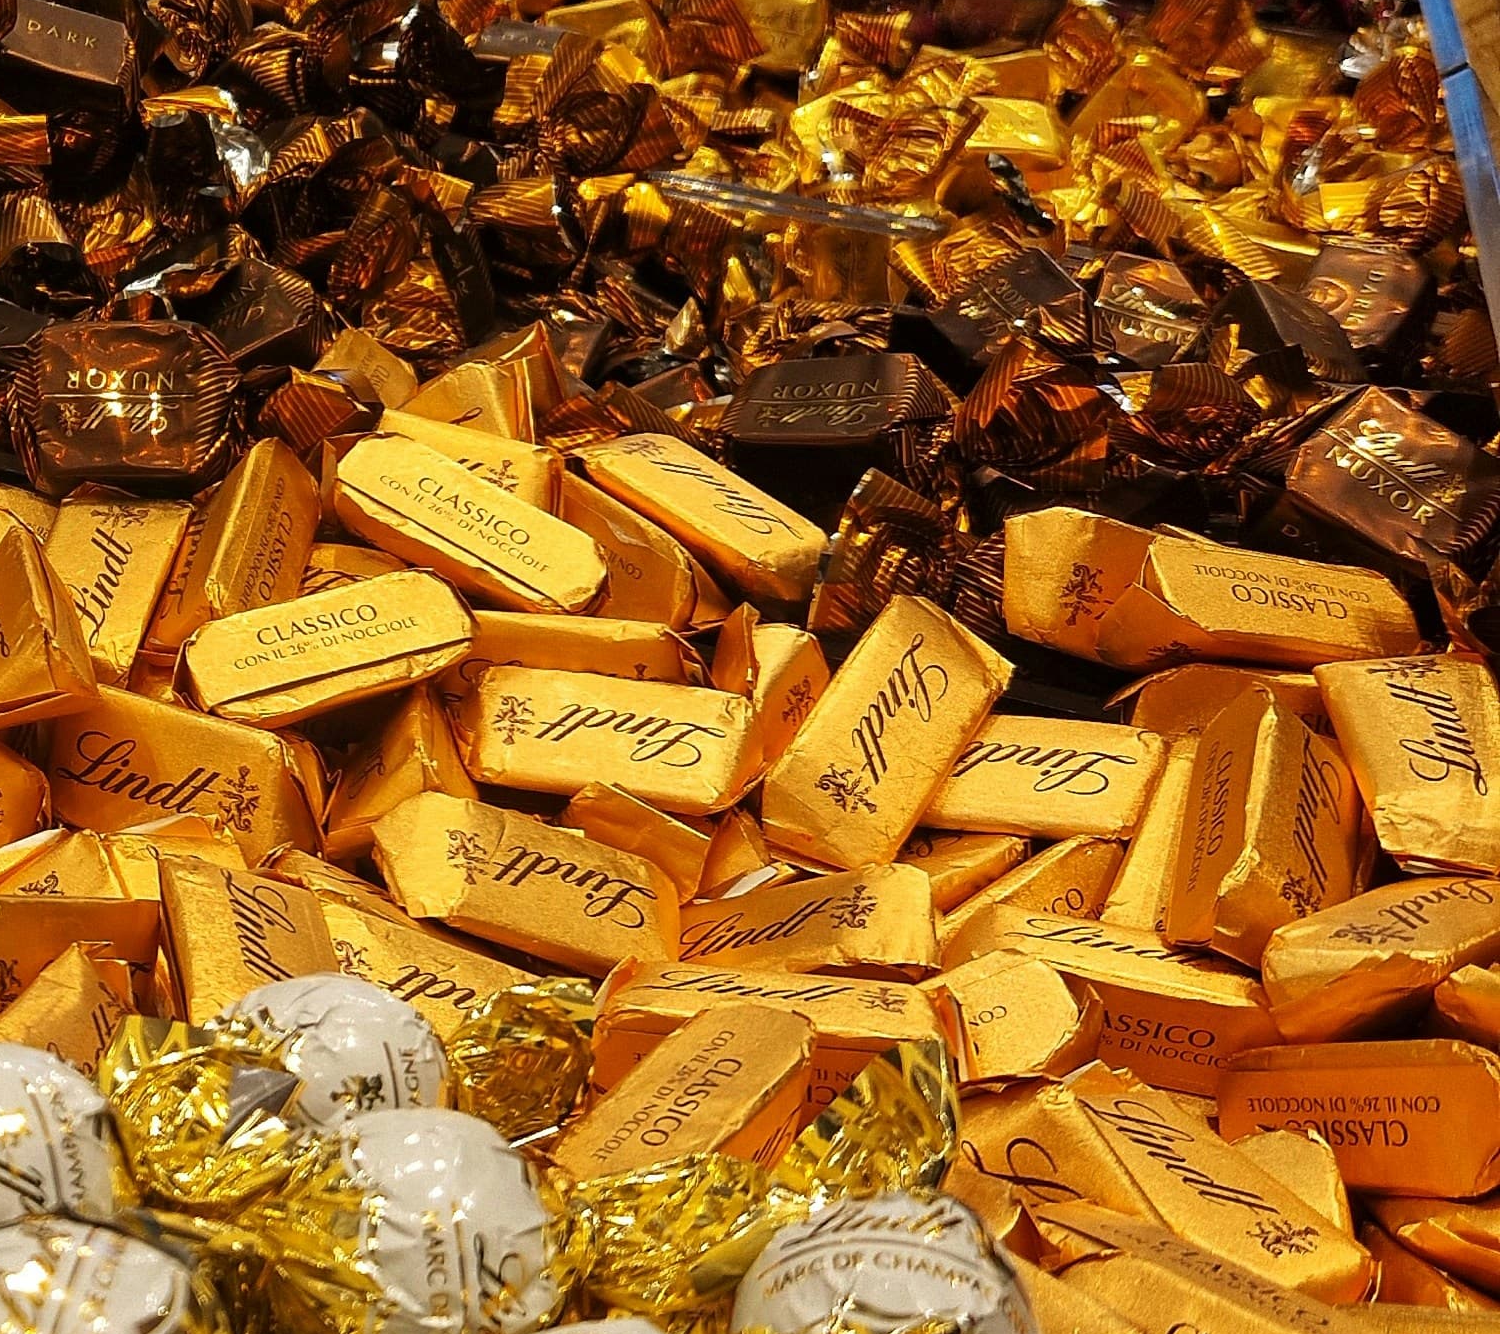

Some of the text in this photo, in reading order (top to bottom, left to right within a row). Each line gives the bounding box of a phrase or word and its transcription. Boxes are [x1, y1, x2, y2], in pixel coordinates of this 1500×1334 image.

[26, 18, 101, 50] DARK
[1348, 268, 1386, 334] DARK
[66, 370, 174, 391] NUXOR
[773, 379, 880, 399] NUXOR
[779, 401, 881, 426] Lindt
[418, 476, 532, 547] CLASSICO
[650, 457, 805, 542] Lindt
[1324, 444, 1436, 527] NUXOR
[379, 474, 411, 498] CON
[427, 503, 456, 525] 26%
[457, 518, 476, 534] DI
[477, 530, 551, 573] NOCCIOLE
[75, 525, 135, 647] Lindt
[259, 510, 294, 603] CLASSICO
[1193, 563, 1272, 587] NOCCIOLE
[1271, 575, 1291, 588] DI
[1293, 578, 1324, 595] 26%
[256, 603, 379, 647] CLASSICO
[1231, 584, 1349, 620] CLASSICO
[1341, 587, 1372, 603] CON
[233, 616, 419, 670] CON IL 26% DI NOCCIOLE
[539, 702, 727, 768] Lindt
[852, 632, 950, 786] Lindt
[1408, 677, 1490, 796] Lindt
[62, 729, 222, 814] Lindt
[1206, 750, 1233, 856] CLASSICO
[1293, 735, 1342, 895] Lindt
[492, 846, 658, 929] Lindt
[1397, 879, 1499, 929] Lindt
[220, 869, 297, 983] Lindt
[679, 897, 832, 963] Lindt
[646, 970, 854, 1004] Lindt
[710, 1029, 736, 1054] CON
[1102, 1010, 1217, 1049] ASSICO
[1119, 1037, 1143, 1053] DI
[640, 1058, 743, 1148] CLASSICO
[651, 1084, 675, 1103] DI
[1247, 1096, 1441, 1113] CON IL 26% DI NOCCIOLE
[590, 1102, 660, 1164] NOCCIOLE
[1080, 1098, 1282, 1220] Lindt
